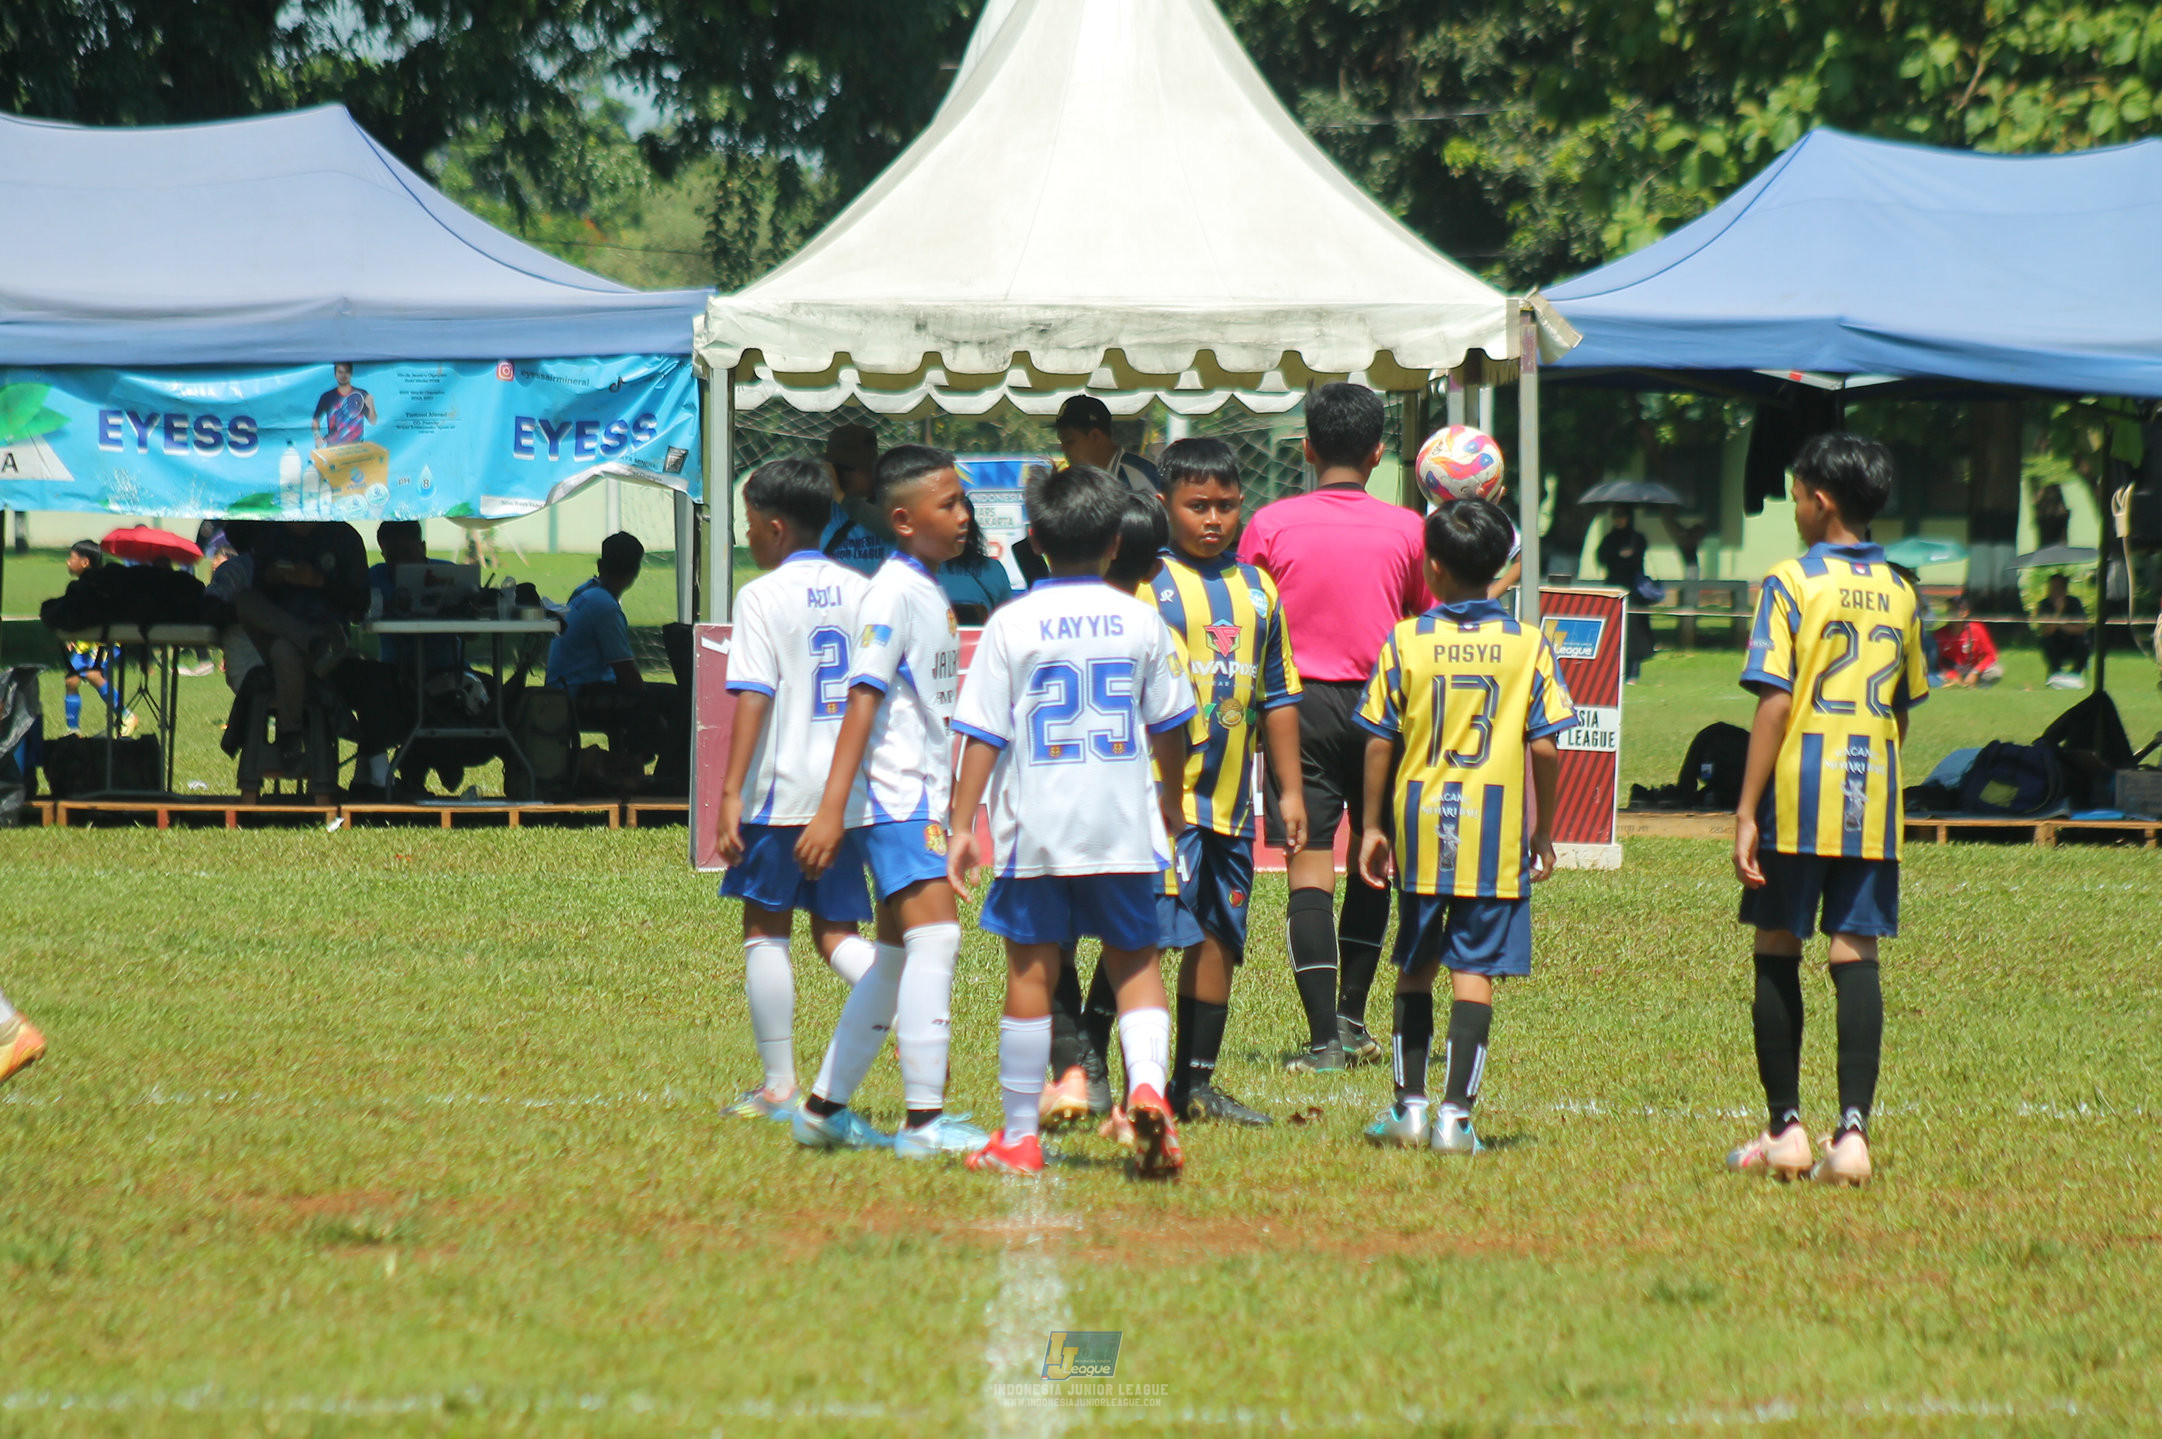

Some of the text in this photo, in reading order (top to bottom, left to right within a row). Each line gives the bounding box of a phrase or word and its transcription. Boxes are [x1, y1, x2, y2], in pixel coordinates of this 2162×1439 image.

[98, 409, 260, 458] EYESS
[514, 412, 658, 461] EYESS
[1839, 588, 1891, 613] ZAEN
[1039, 614, 1125, 642] KAYYIS
[1433, 643, 1503, 665] PASYA
[1553, 643, 1593, 657] League
[809, 625, 852, 722] 2
[1812, 620, 1904, 719] 22
[1027, 658, 1137, 766] 25
[1425, 674, 1500, 769] 13
[1578, 710, 1599, 728] SIA
[1567, 729, 1616, 748] LEAGUE
